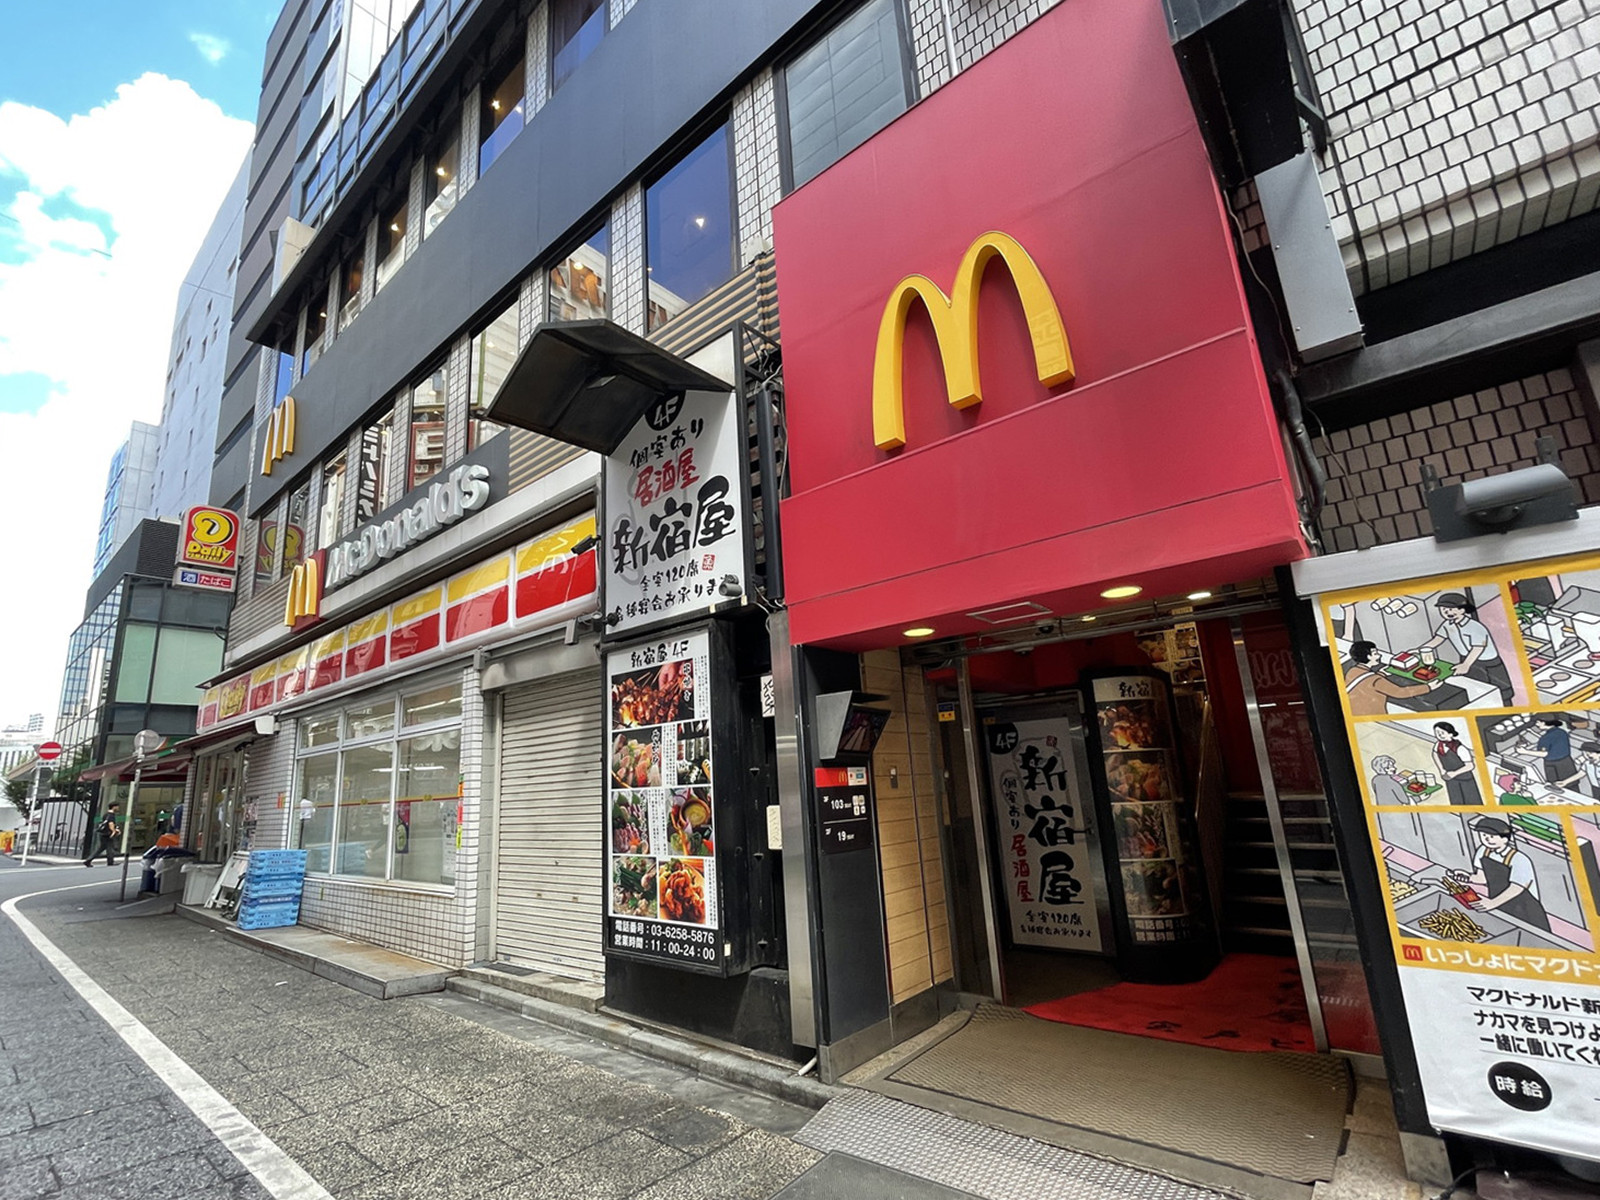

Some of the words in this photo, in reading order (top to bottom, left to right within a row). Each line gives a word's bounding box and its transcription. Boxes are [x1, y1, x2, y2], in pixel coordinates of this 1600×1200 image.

[653, 395, 679, 426] 4F
[629, 418, 704, 468] 個室あり
[634, 448, 700, 507] 居酒屋
[613, 475, 736, 574] 新宿屋
[187, 541, 234, 563] Daily
[199, 575, 231, 588] たばこ
[631, 643, 668, 668] 新宿屋
[995, 732, 1017, 749] 4F
[831, 799, 844, 810] 103
[1003, 777, 1020, 830] 個室あり
[837, 831, 847, 841] 19
[1019, 745, 1084, 905] 新宿屋
[1010, 834, 1034, 902] 居酒屋
[1425, 945, 1600, 978] いっしょにマクド
[1494, 1075, 1544, 1099] 時給
